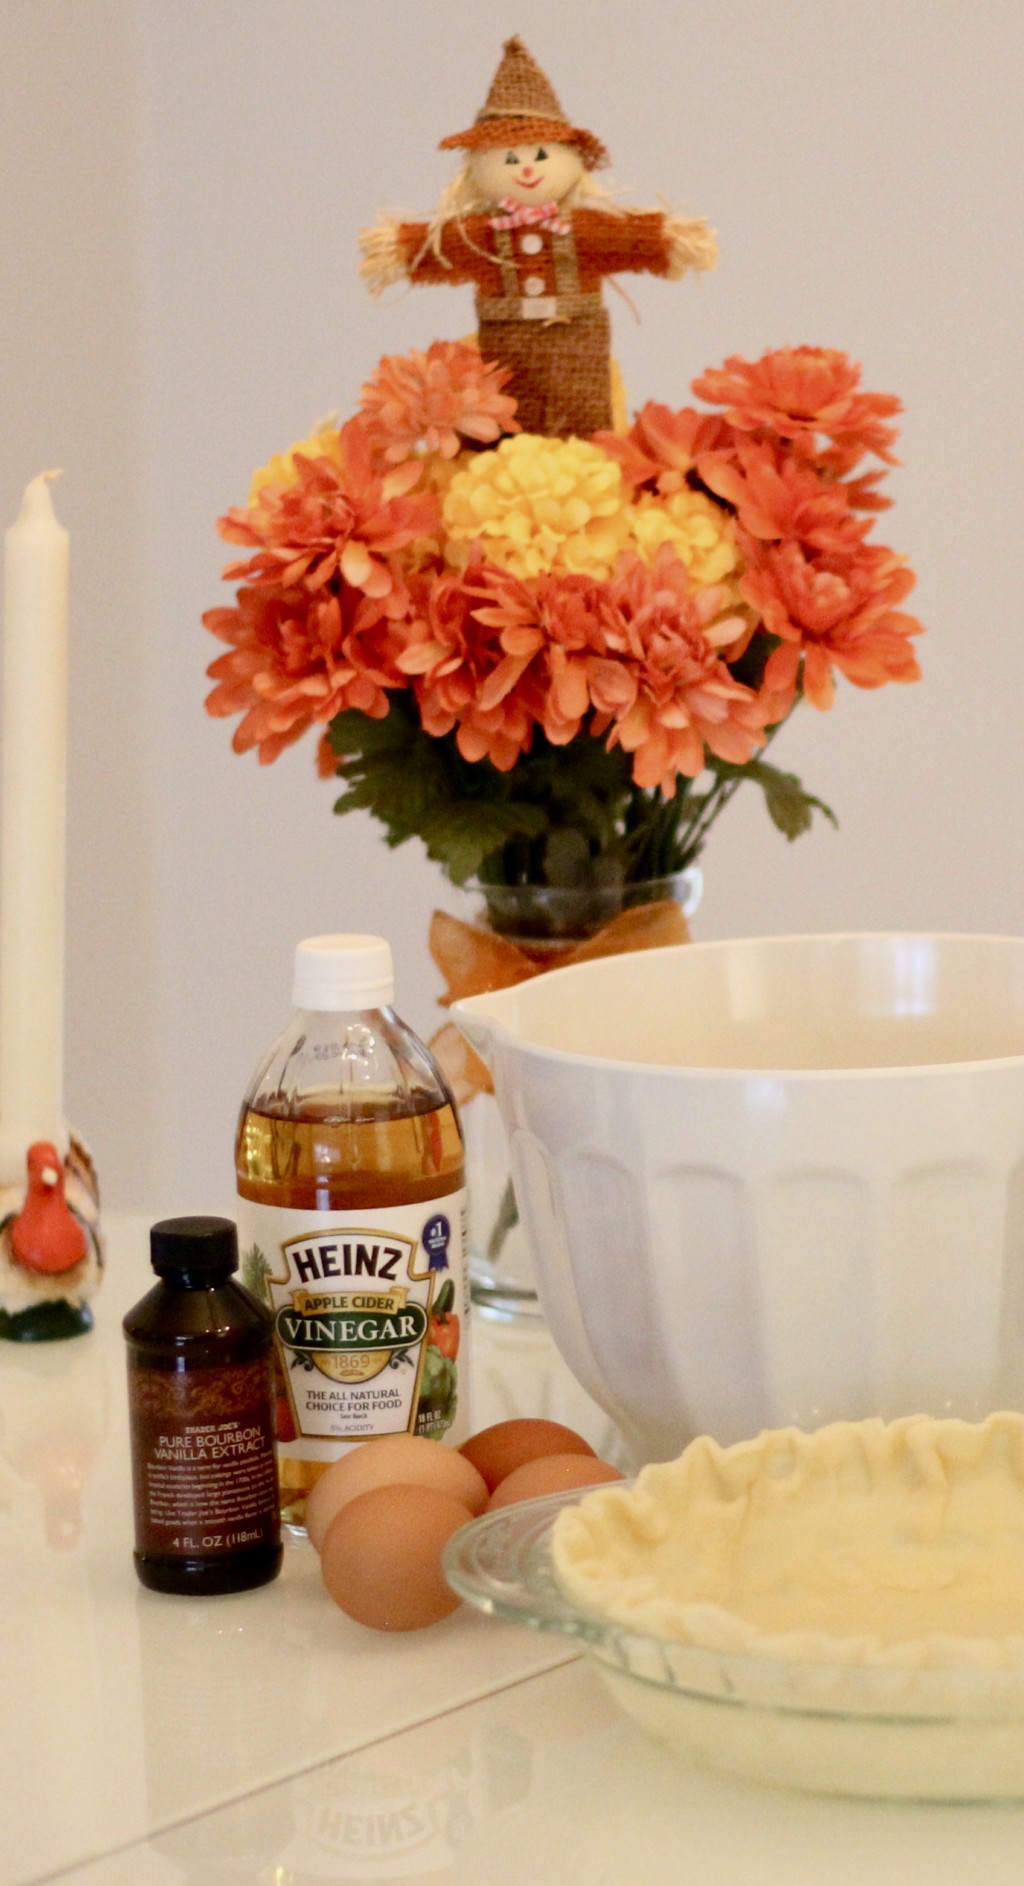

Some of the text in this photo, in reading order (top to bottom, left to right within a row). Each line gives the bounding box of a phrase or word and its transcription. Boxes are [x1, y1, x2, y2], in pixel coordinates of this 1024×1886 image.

[292, 1244, 403, 1283] HEINZ
[304, 1295, 394, 1311] APPLE CIDER
[284, 1315, 418, 1342] VINEGAR
[332, 1353, 371, 1369] 1869
[306, 1388, 400, 1400] THE ALL NATURAL
[306, 1399, 402, 1411] CHOICE FOR FOOD
[185, 1425, 216, 1434] TRADER
[344, 1423, 374, 1432] ACIDITY
[159, 1426, 261, 1448] PURE BOURBON
[154, 1435, 266, 1460] VANILLA EXTRACT
[172, 1538, 180, 1547] 4
[202, 1535, 222, 1547] OZ
